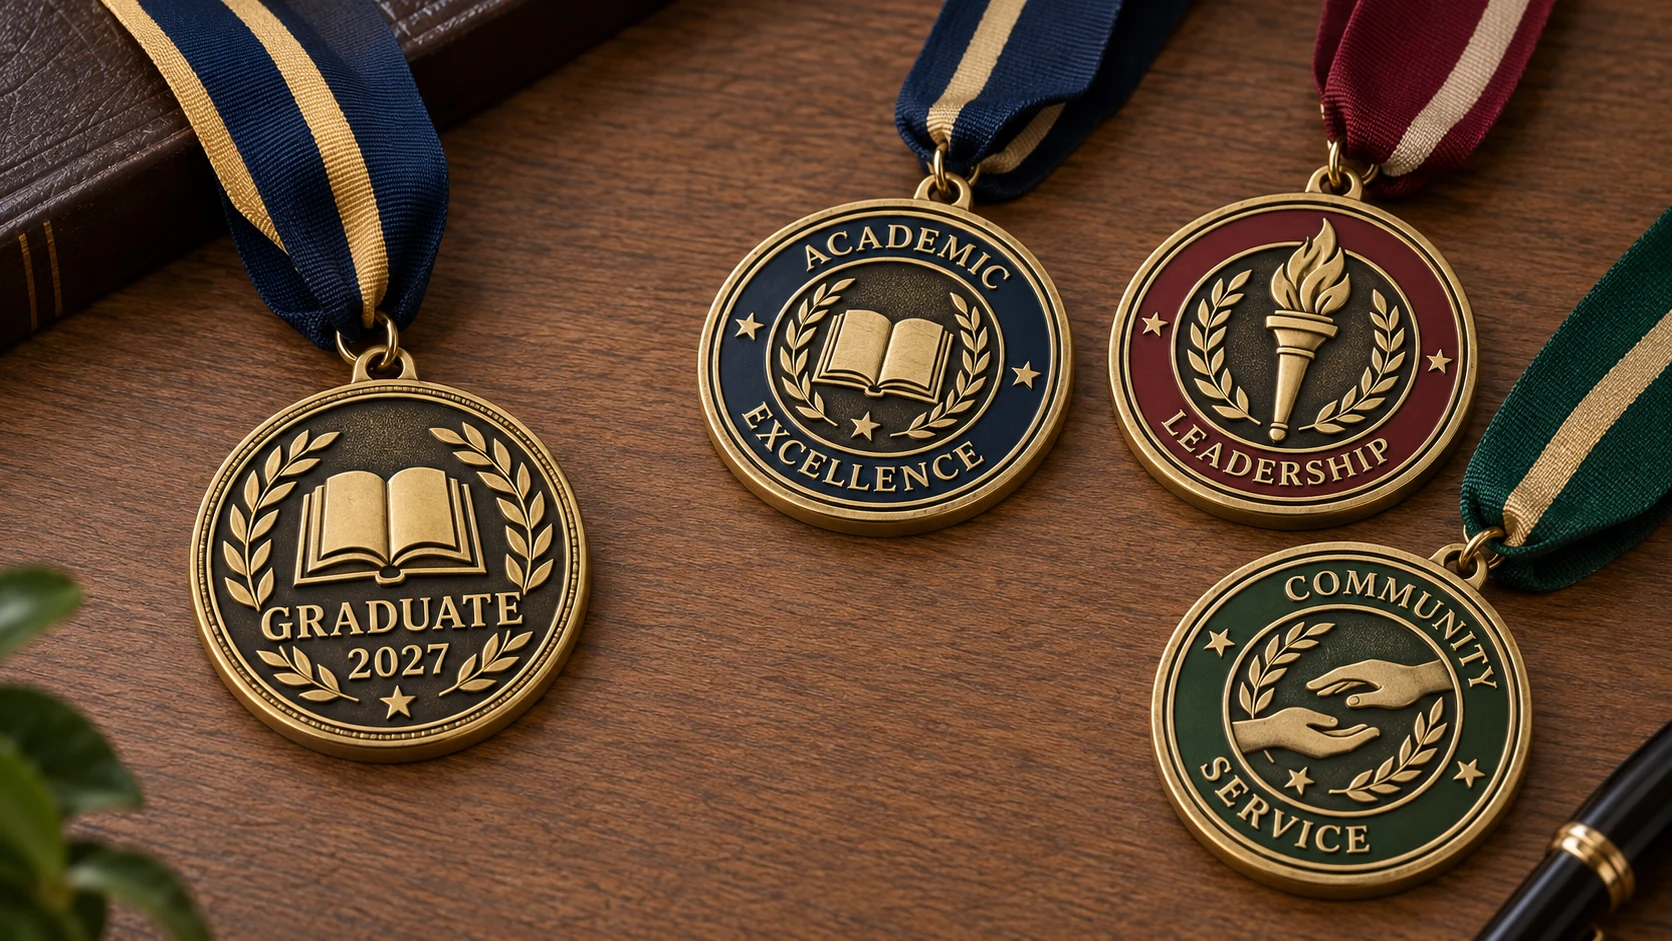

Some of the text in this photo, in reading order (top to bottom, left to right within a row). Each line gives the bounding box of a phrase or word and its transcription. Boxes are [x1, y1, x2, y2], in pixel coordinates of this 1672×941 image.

[803, 223, 1011, 290] ACADEMIC
[742, 401, 985, 493] EXCELLENCE
[1161, 408, 1390, 487] LEADERSHIP
[260, 591, 524, 641] GRADUATE
[1284, 569, 1498, 689] COMMUNITY
[347, 642, 449, 680] 2027
[1200, 756, 1371, 854] SERVICE
